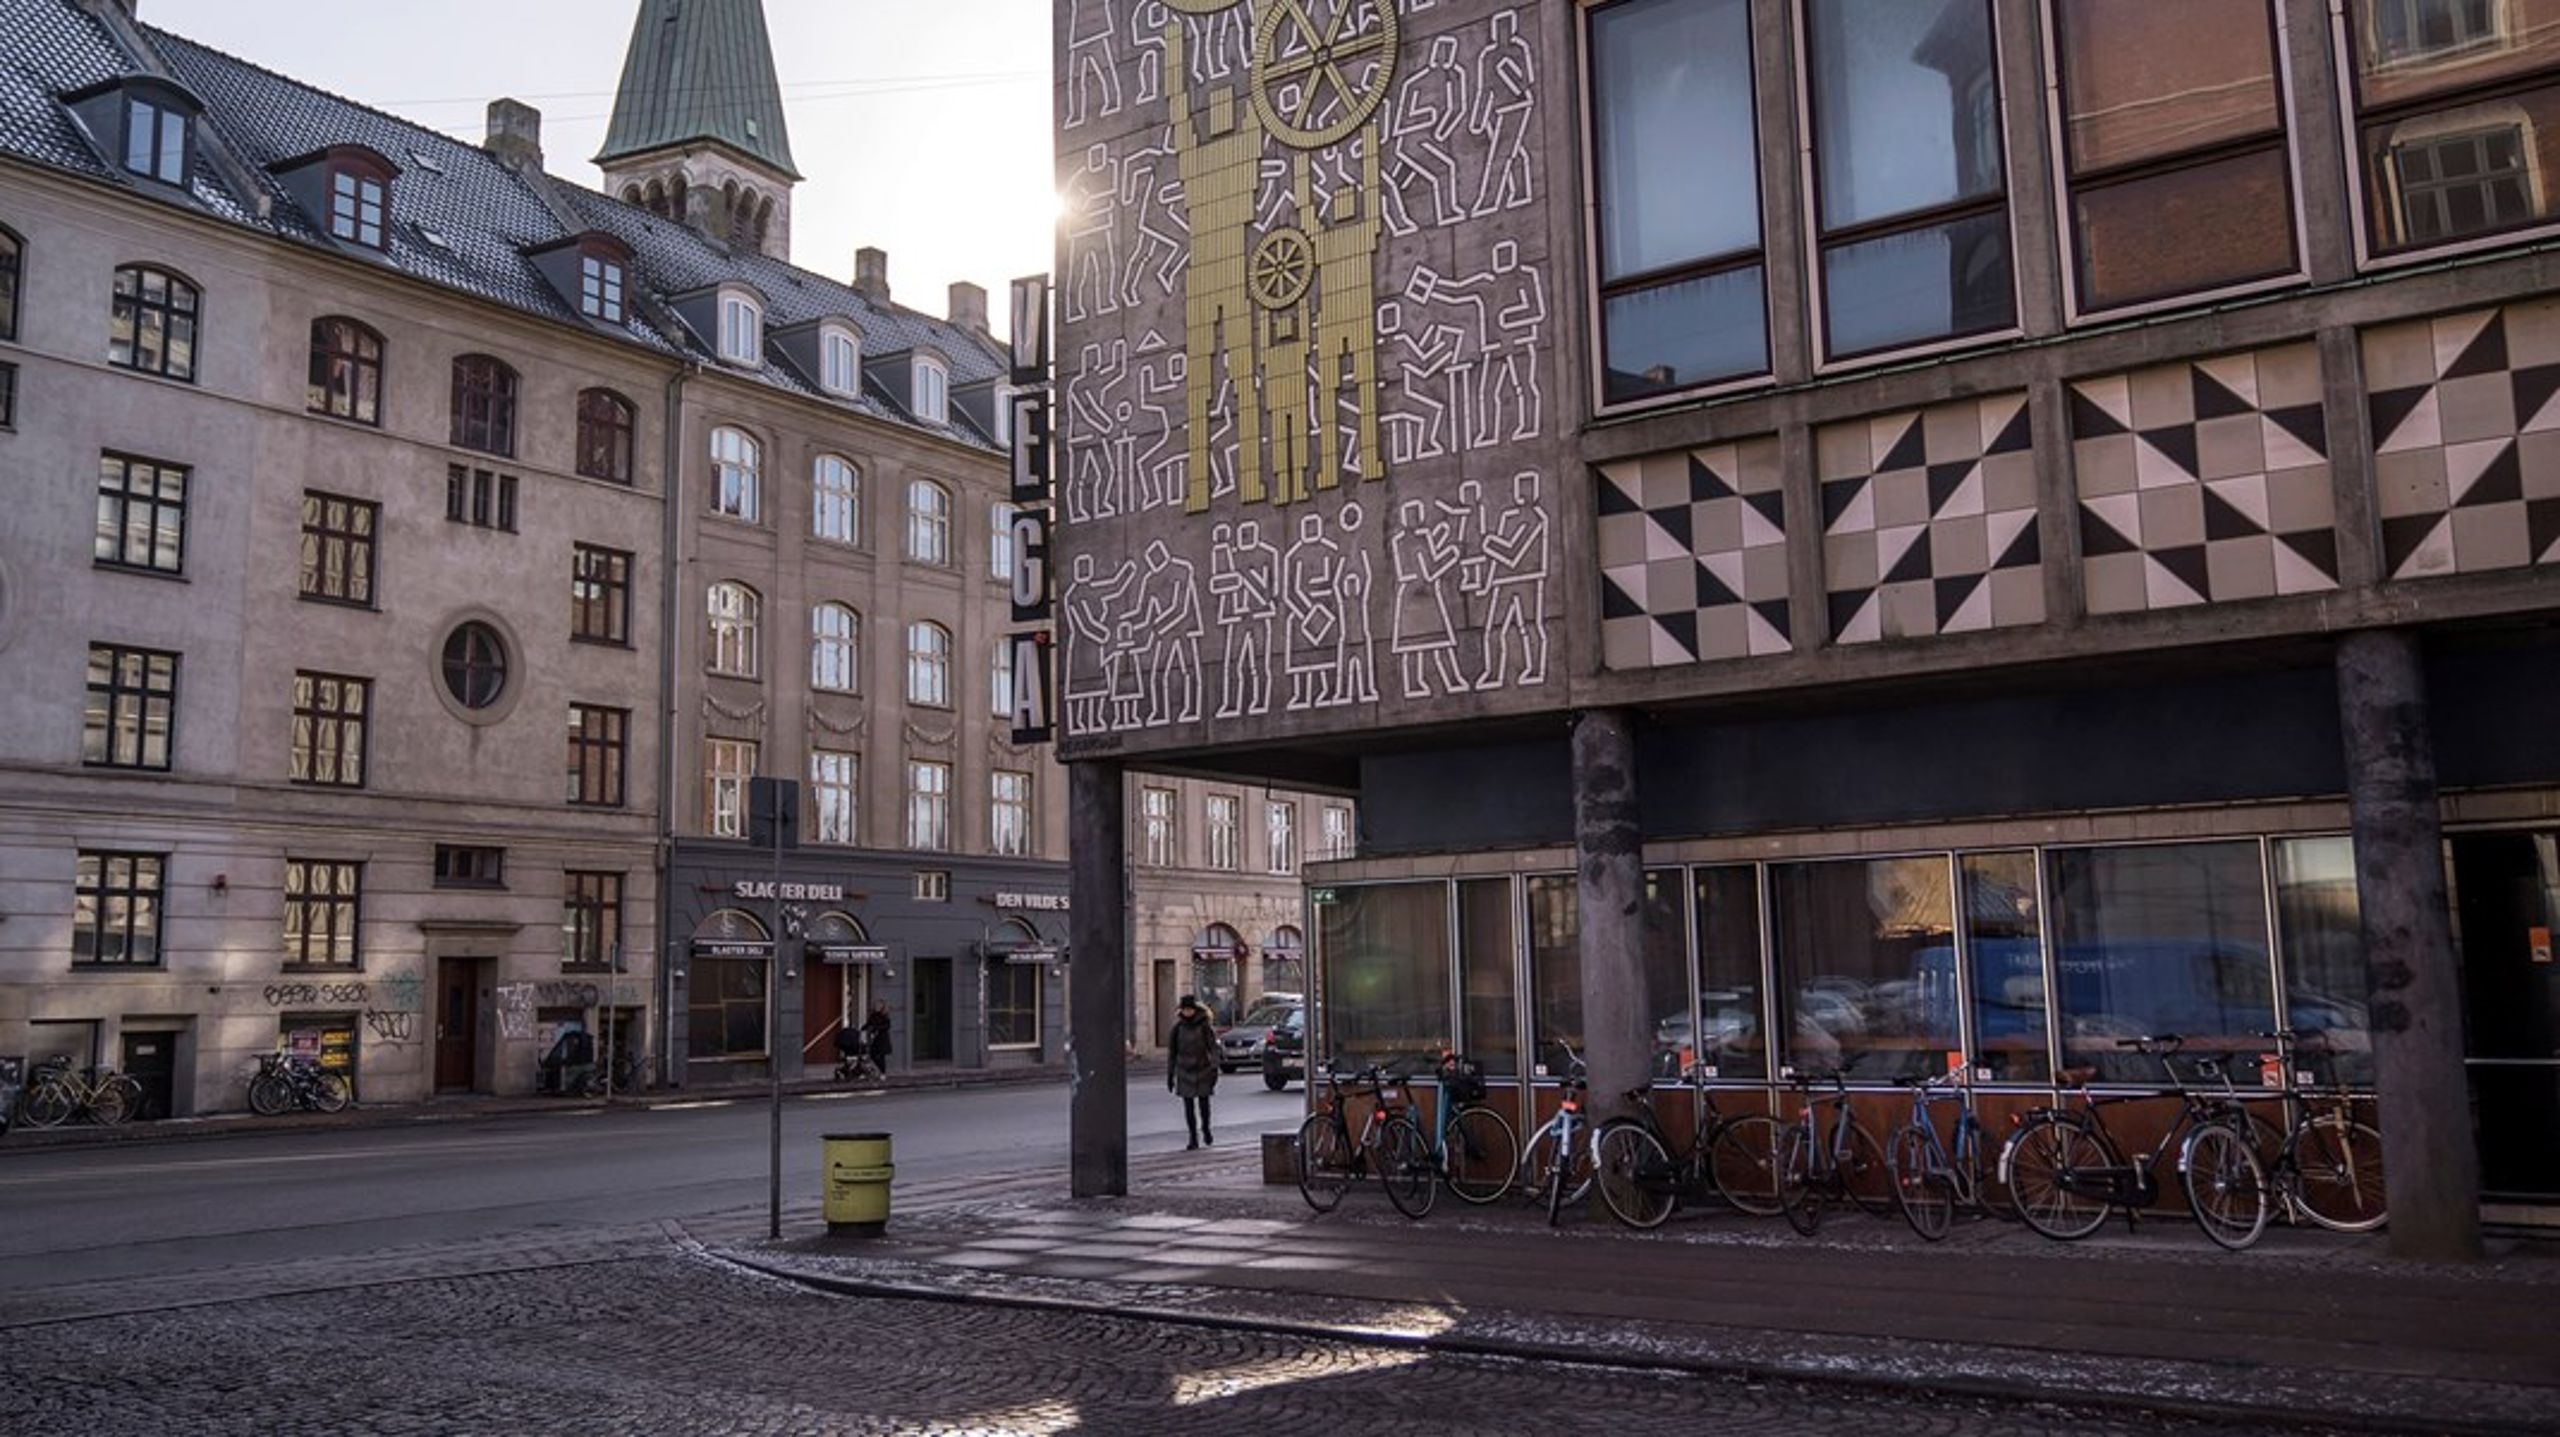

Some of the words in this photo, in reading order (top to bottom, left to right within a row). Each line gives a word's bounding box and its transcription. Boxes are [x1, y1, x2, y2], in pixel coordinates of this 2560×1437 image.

[1012, 281, 1044, 729] VEGA
[808, 884, 843, 900] DELI
[996, 893, 1022, 908] DEN
